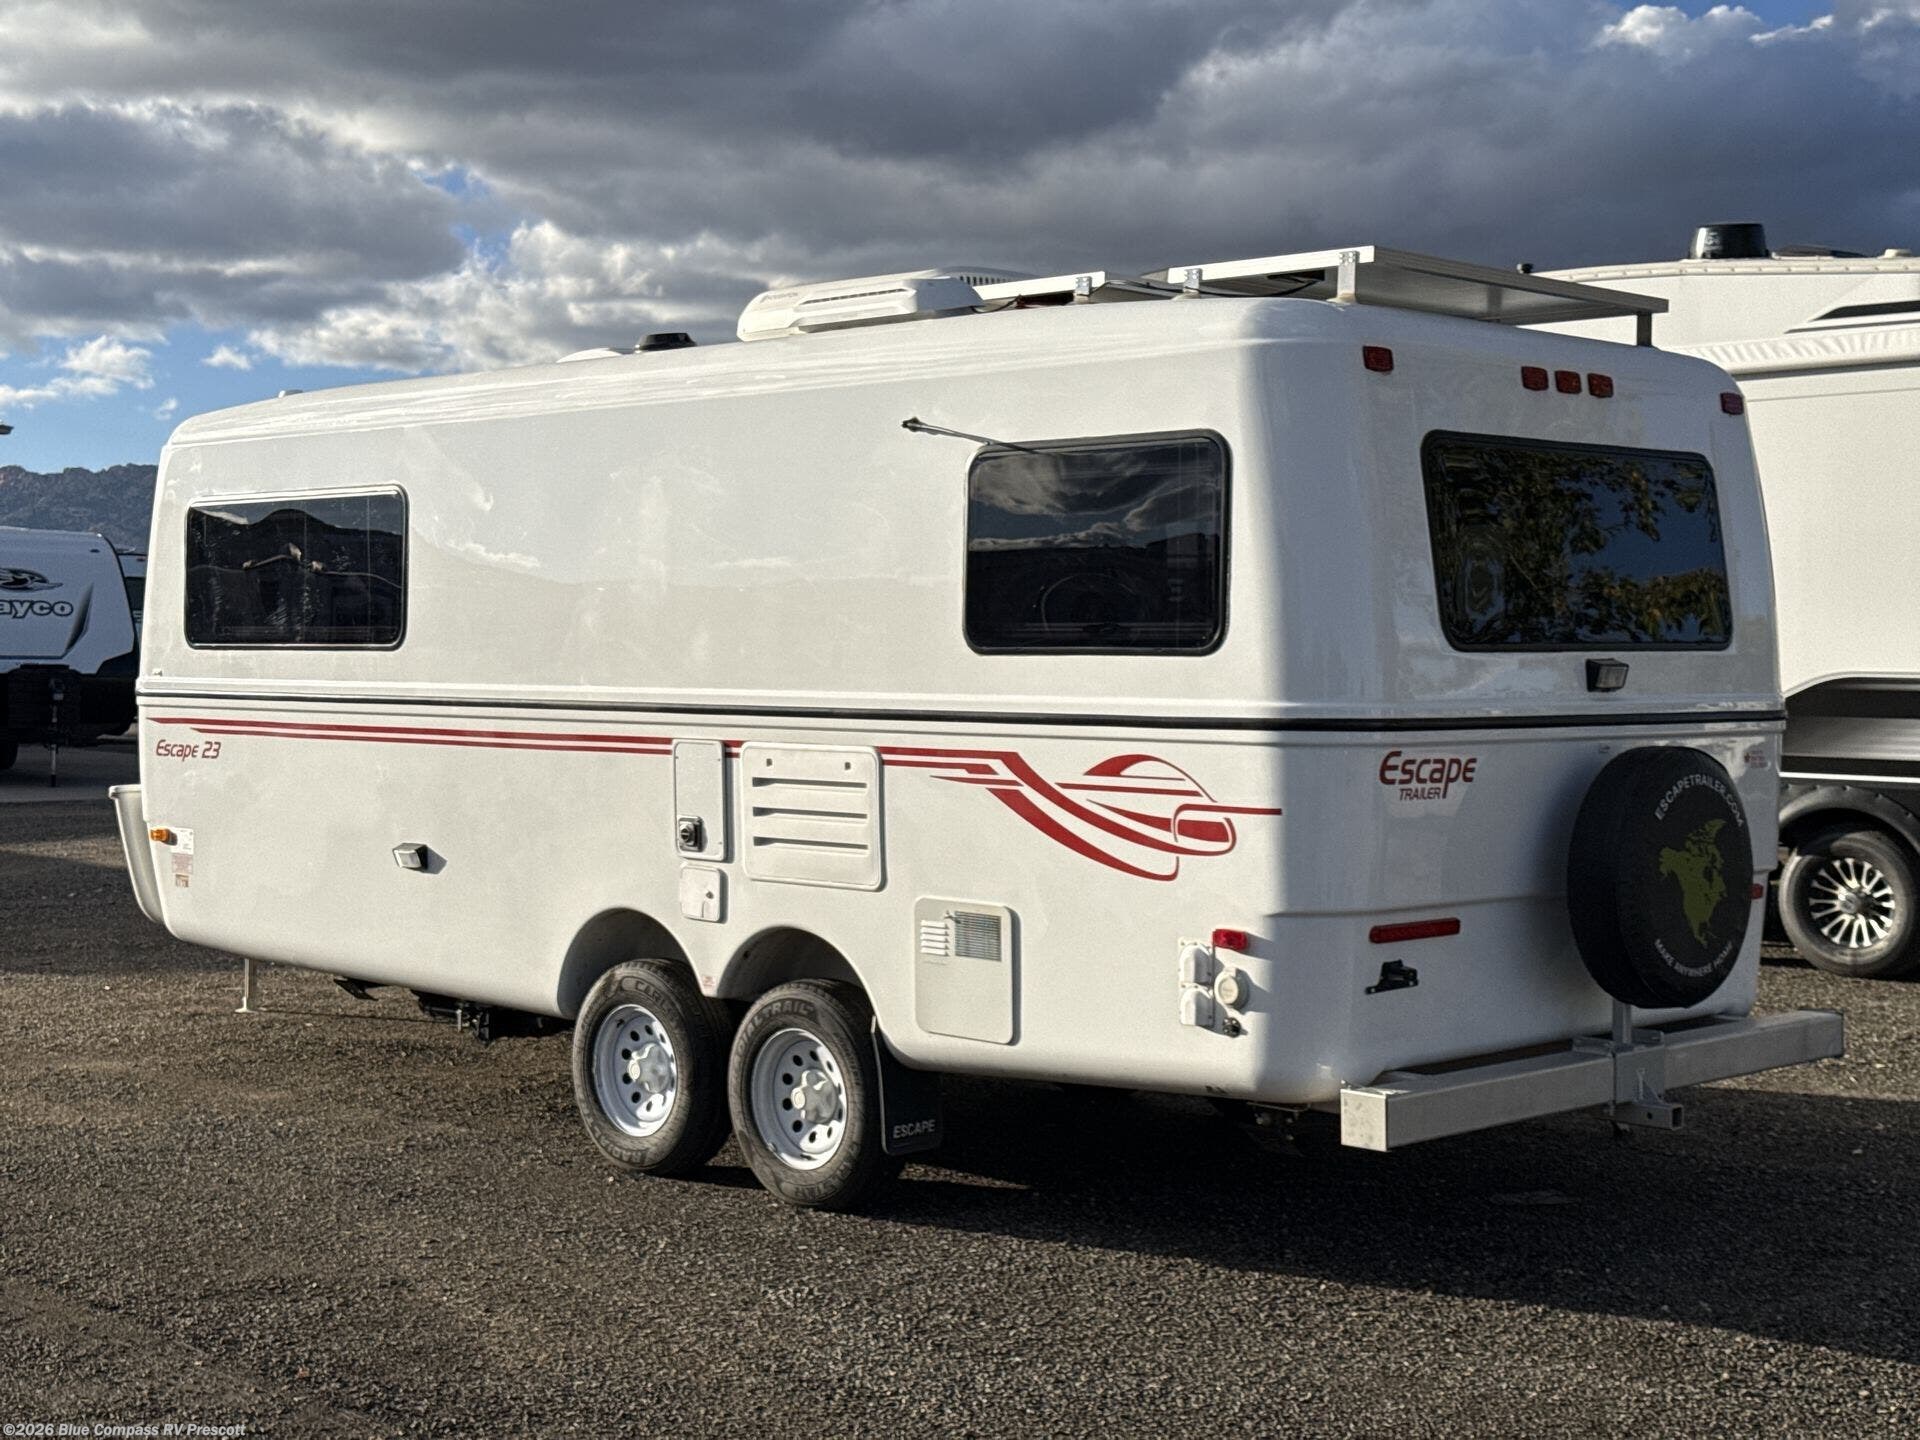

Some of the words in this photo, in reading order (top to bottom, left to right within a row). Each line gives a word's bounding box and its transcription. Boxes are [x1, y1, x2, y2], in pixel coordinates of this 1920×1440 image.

[0, 599, 74, 619] ayco
[156, 739, 199, 762] Escape
[202, 741, 222, 759] 23
[1379, 750, 1478, 799] Escape
[1399, 787, 1441, 801] TRAILER
[892, 1119, 936, 1139] ESCAPE
